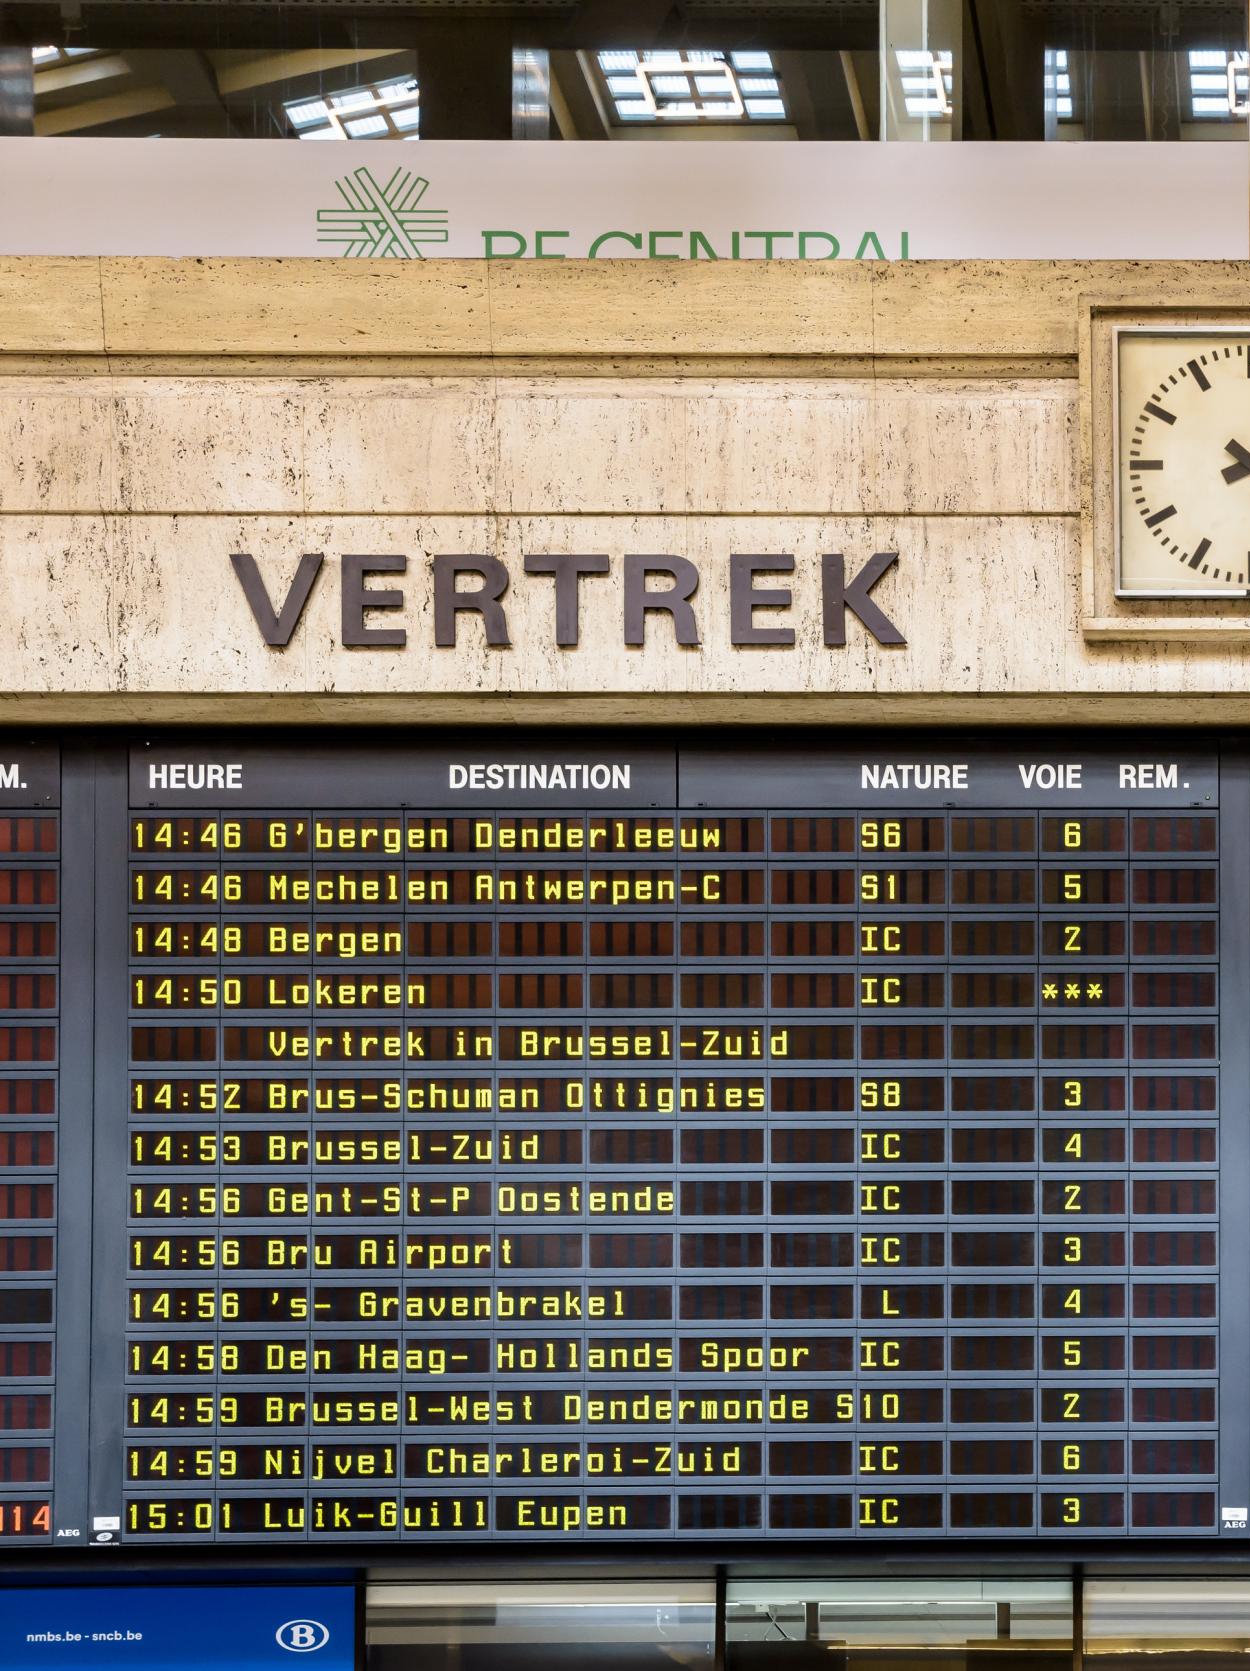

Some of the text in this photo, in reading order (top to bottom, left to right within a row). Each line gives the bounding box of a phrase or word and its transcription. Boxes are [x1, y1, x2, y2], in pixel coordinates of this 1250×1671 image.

[230, 552, 908, 647] VERTREK
[149, 763, 1190, 790] HEURE DESTINATION NATURE VOIE REM.
[135, 822, 1081, 854] 14:46 G'bergen Denderleeuw S6 6
[135, 874, 1081, 905] 14:46 Mechelen Antwerpen-C S1 5
[135, 925, 1081, 958] 14:48 Bergen IC 2
[135, 978, 901, 1005] 14:50 Lokeren IC
[269, 1030, 788, 1057] Vertrek in Brussel-Zuid
[135, 1081, 1082, 1112] 14:52 Brus-Schuman Ottignies S8 3
[135, 1133, 1082, 1162] 14:53 Brussel-Zuid IC 4
[134, 1184, 1081, 1214] 14:56 Gent-St-P Oostende IC 2
[133, 1236, 1081, 1269] 14:56 Bru Airport IC 3
[133, 1288, 1081, 1319] 14:56 's- Gravenbrakel L 4
[132, 1340, 1081, 1375] 14:58 Den Haag- Hollands Spoor IC 5
[132, 1392, 1080, 1424] 14:59 Brussel-West Dendermonde S10 2
[130, 1444, 1080, 1481] 14:59 Nijvel Charleroi-Zuid IC 6
[129, 1503, 231, 1530] 15:01
[264, 1500, 485, 1528] Luik-Guill
[518, 1500, 626, 1531] Eupen
[859, 1498, 899, 1524] IC
[1063, 1497, 1080, 1523] 3
[1224, 1520, 1247, 1529] AEG
[57, 1529, 81, 1537] AEG
[26, 1629, 143, 1643] nmbs.be sncb.be
